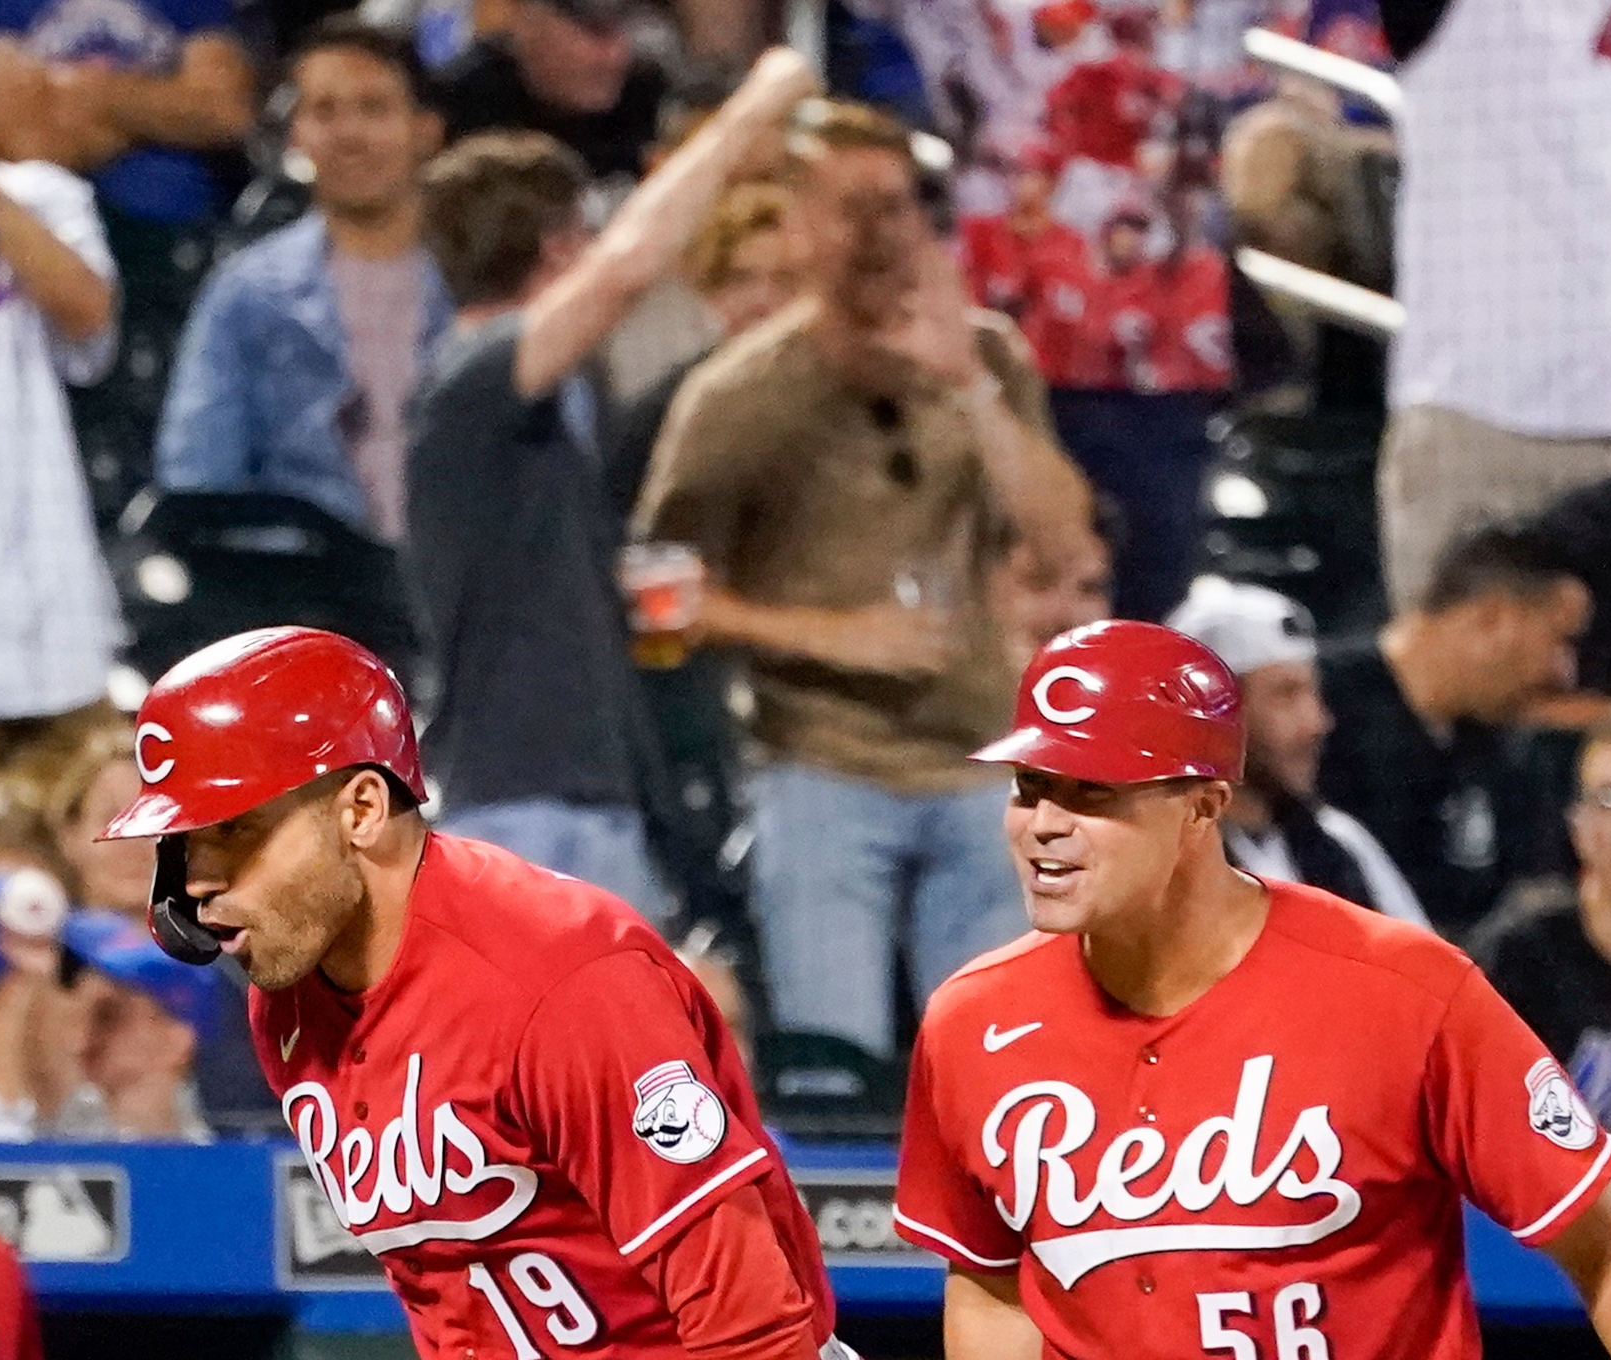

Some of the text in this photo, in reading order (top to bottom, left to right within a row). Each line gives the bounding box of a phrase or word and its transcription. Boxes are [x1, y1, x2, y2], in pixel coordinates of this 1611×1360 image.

[135, 721, 175, 785] C
[1032, 665, 1104, 725] C
[281, 1053, 538, 1256] Reds
[982, 1054, 1362, 1290] Reds
